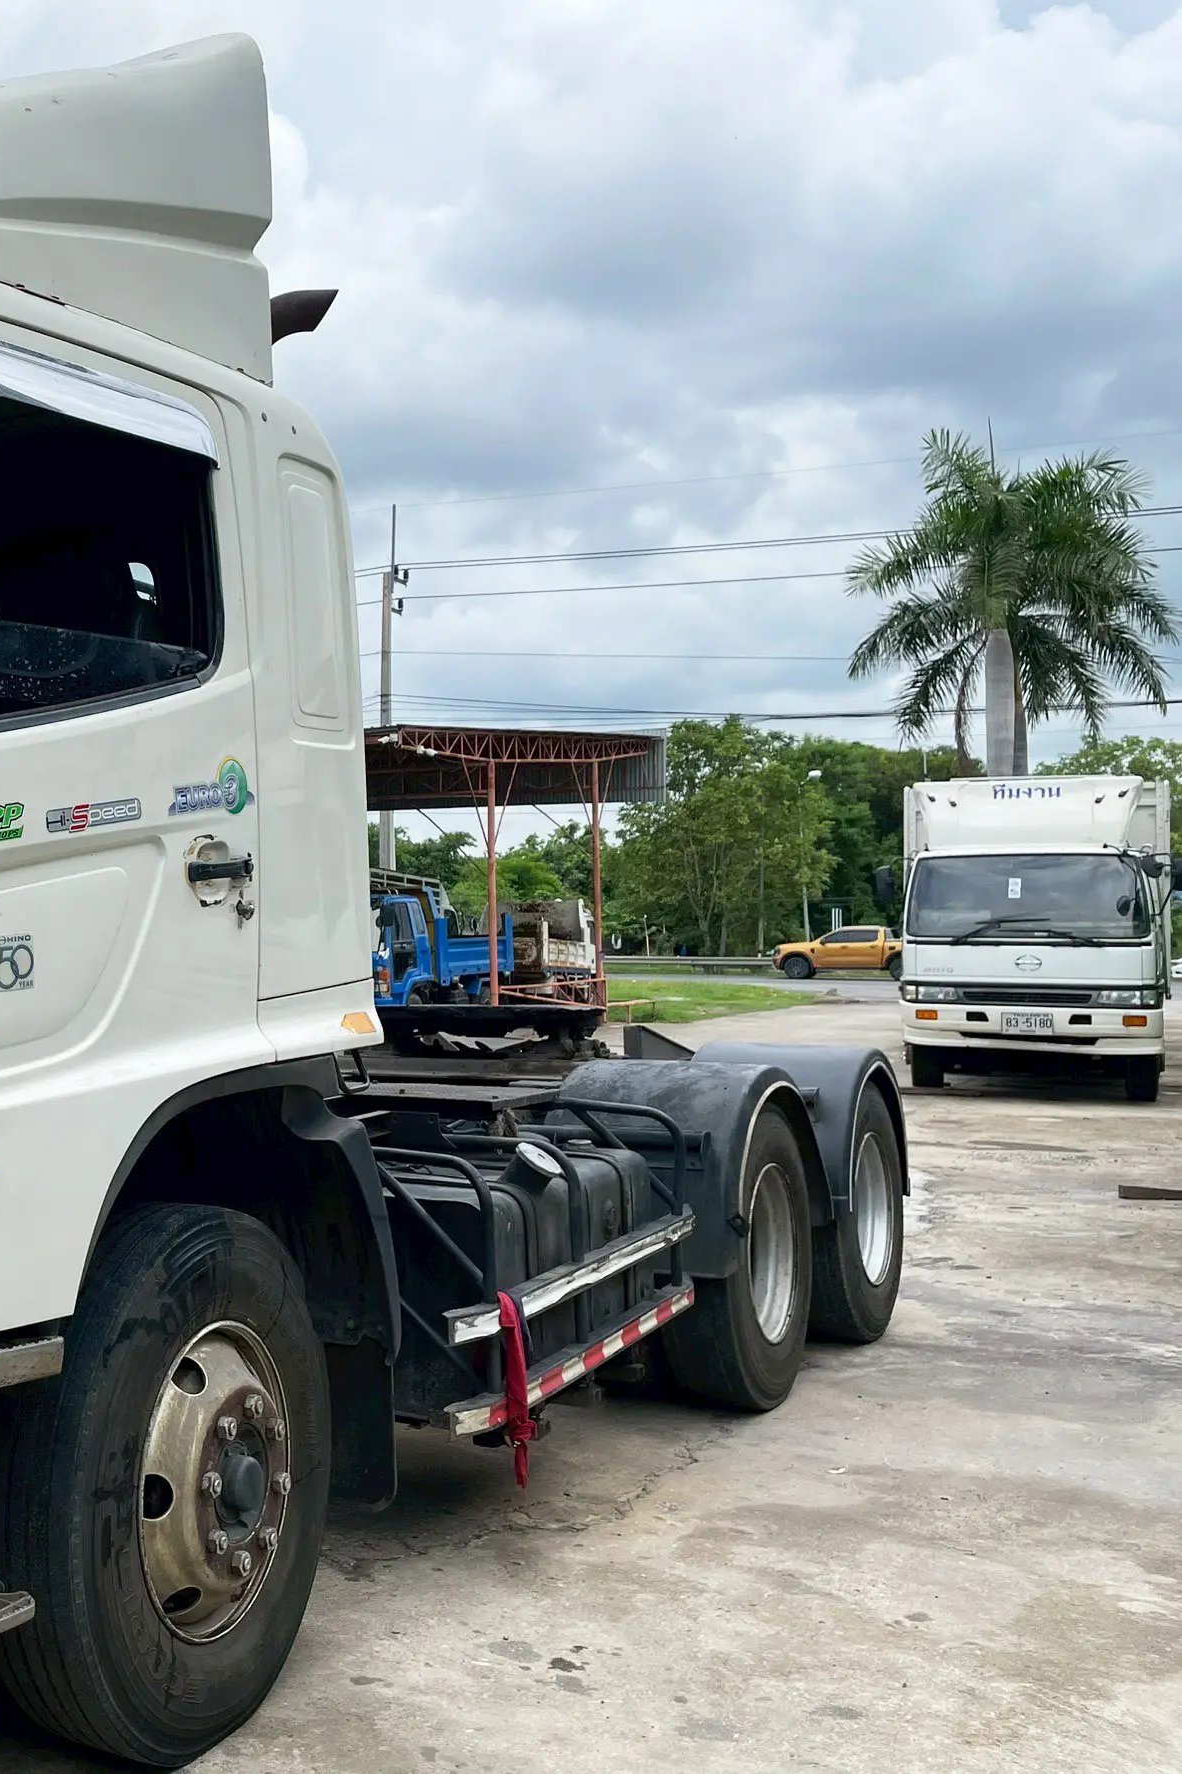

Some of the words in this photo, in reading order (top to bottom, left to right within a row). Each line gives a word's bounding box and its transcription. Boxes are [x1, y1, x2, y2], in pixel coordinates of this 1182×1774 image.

[992, 784, 1061, 800] ทีมงาน
[7, 934, 31, 943] HINO
[19, 980, 34, 989] YEAR
